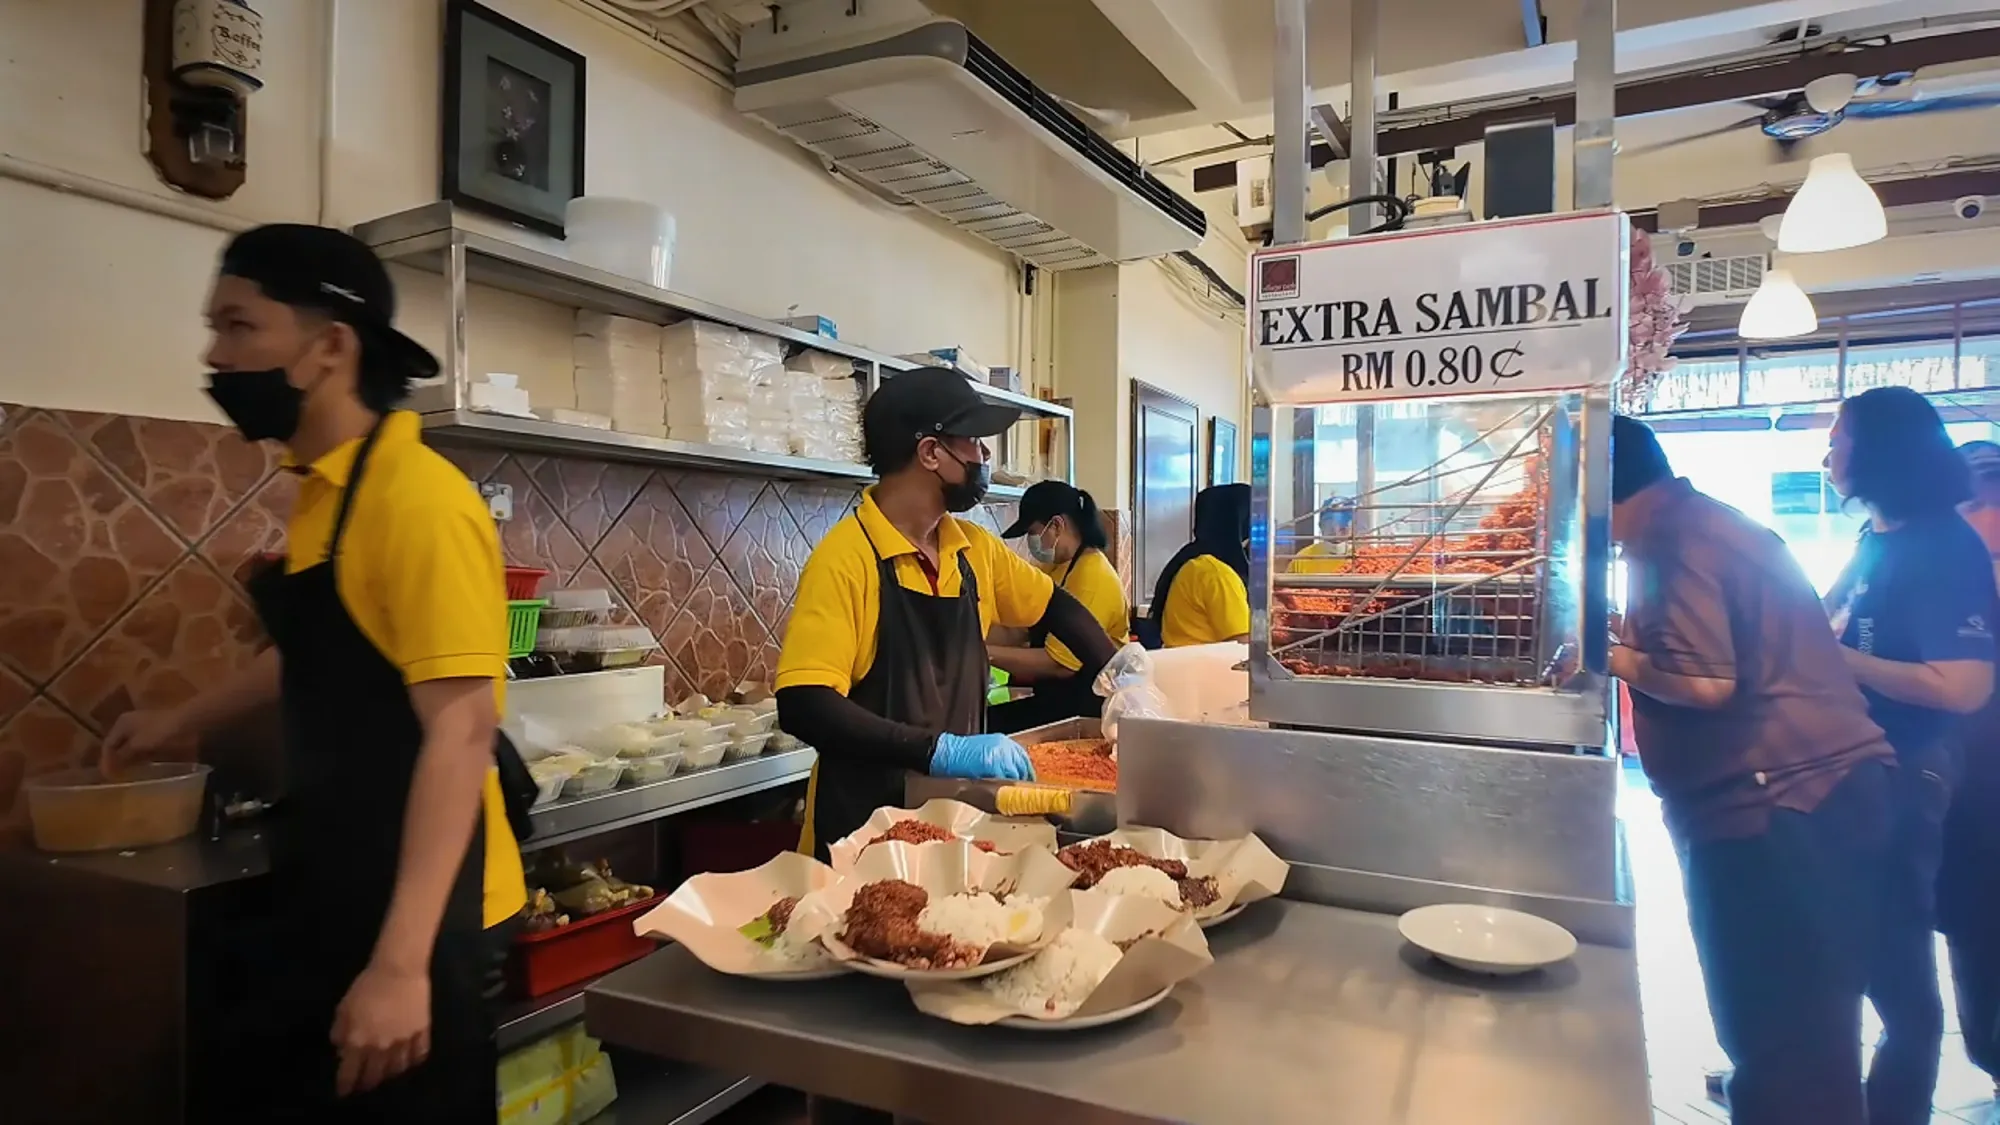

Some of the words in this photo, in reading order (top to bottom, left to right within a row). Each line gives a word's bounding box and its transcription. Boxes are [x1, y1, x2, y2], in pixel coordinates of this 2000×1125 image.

[1260, 297, 1402, 346] EXTRA
[1416, 278, 1611, 333] SAMBAL
[1341, 351, 1394, 391] RM
